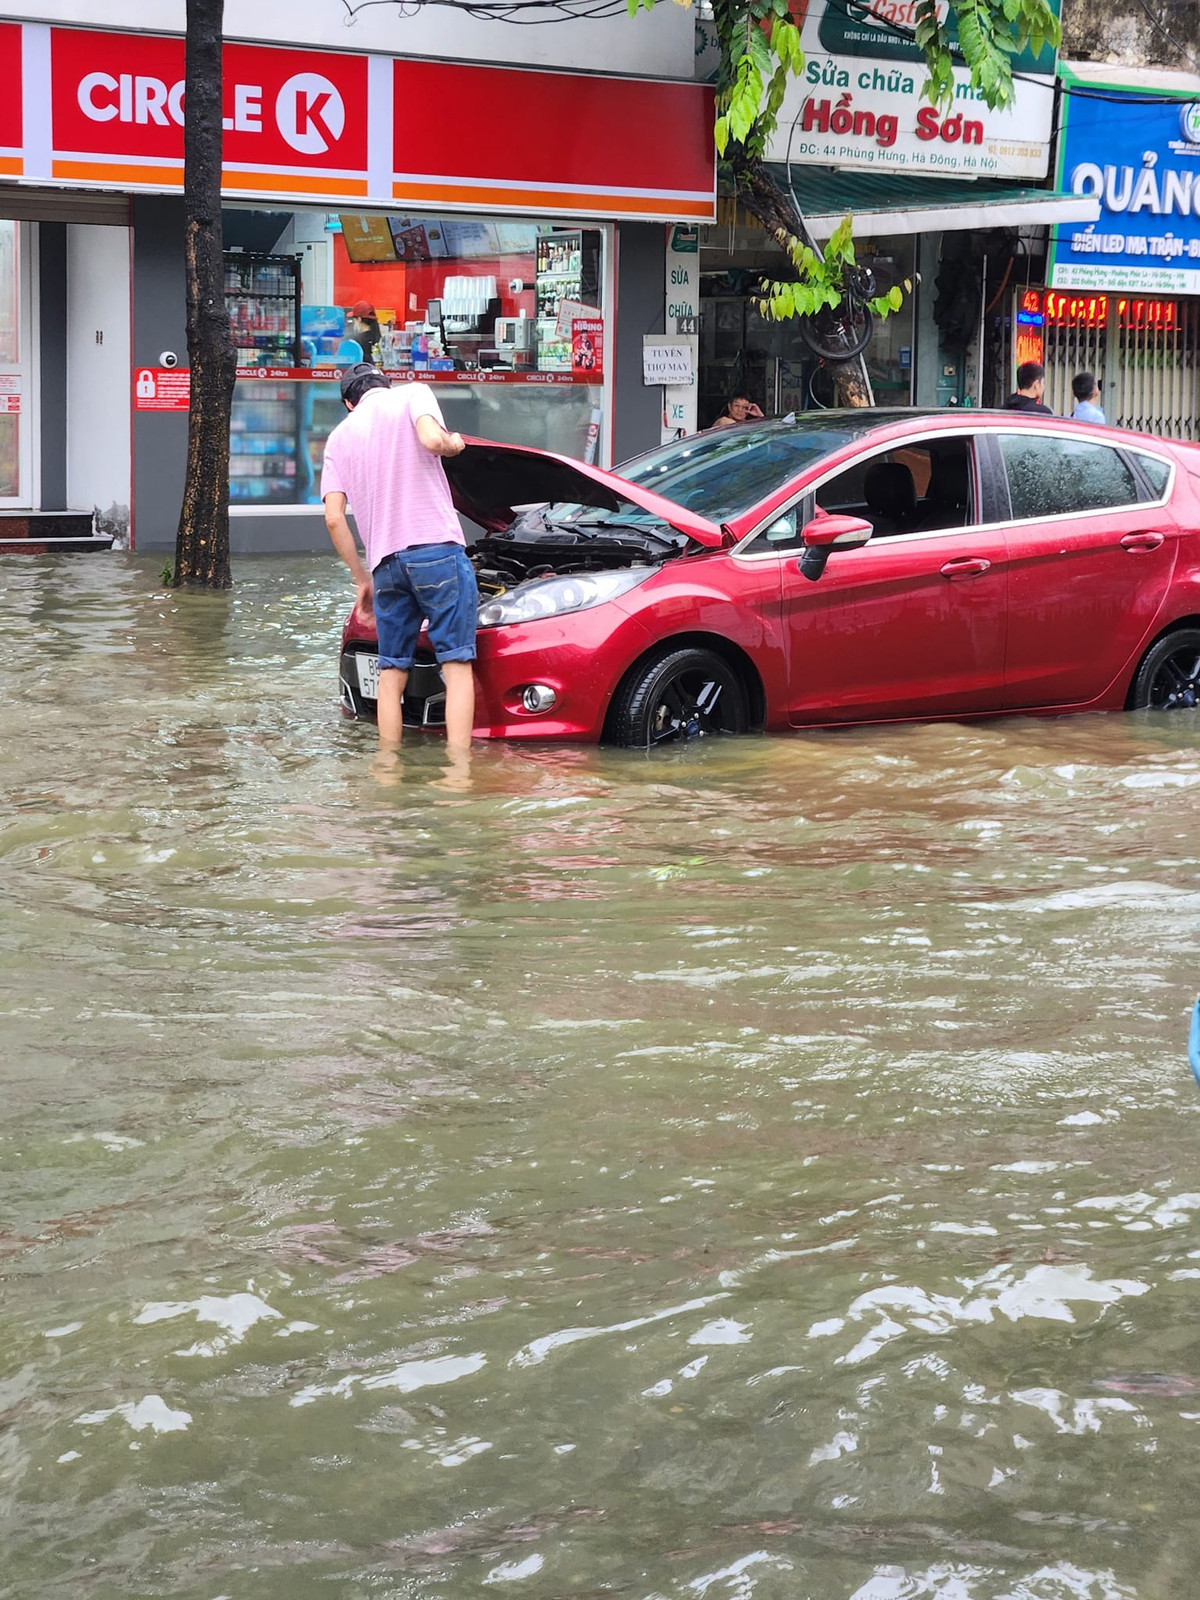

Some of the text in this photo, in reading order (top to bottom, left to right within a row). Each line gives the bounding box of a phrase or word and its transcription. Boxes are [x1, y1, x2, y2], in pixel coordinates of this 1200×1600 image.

[806, 61, 850, 88] Sửa
[858, 68, 914, 94] chữa
[802, 93, 985, 147] Hồng Sơn
[799, 143, 820, 155] ĐC:
[823, 145, 836, 156] 44
[839, 147, 874, 161] Phùng
[878, 150, 909, 164] Hưng,
[912, 153, 926, 163] Hà
[930, 154, 961, 168] Đông,
[963, 157, 977, 167] Hà
[1072, 150, 1200, 217] QUẢN
[1102, 234, 1125, 254] LED
[1125, 236, 1148, 255] MA
[670, 265, 689, 285] SỬA
[668, 301, 693, 318] CHỮA
[574, 322, 603, 332] HIRING
[681, 319, 695, 333] 44
[235, 369, 258, 378] CIRCLE
[270, 370, 289, 378] 24hrs
[312, 371, 334, 379] CIRCLE
[386, 372, 407, 380] CIRCLE
[418, 373, 436, 381] 24hrs
[456, 373, 478, 381] CIRCLE
[489, 374, 506, 382] 24hrs
[526, 374, 547, 382] CIRCLE
[672, 404, 684, 419] XE
